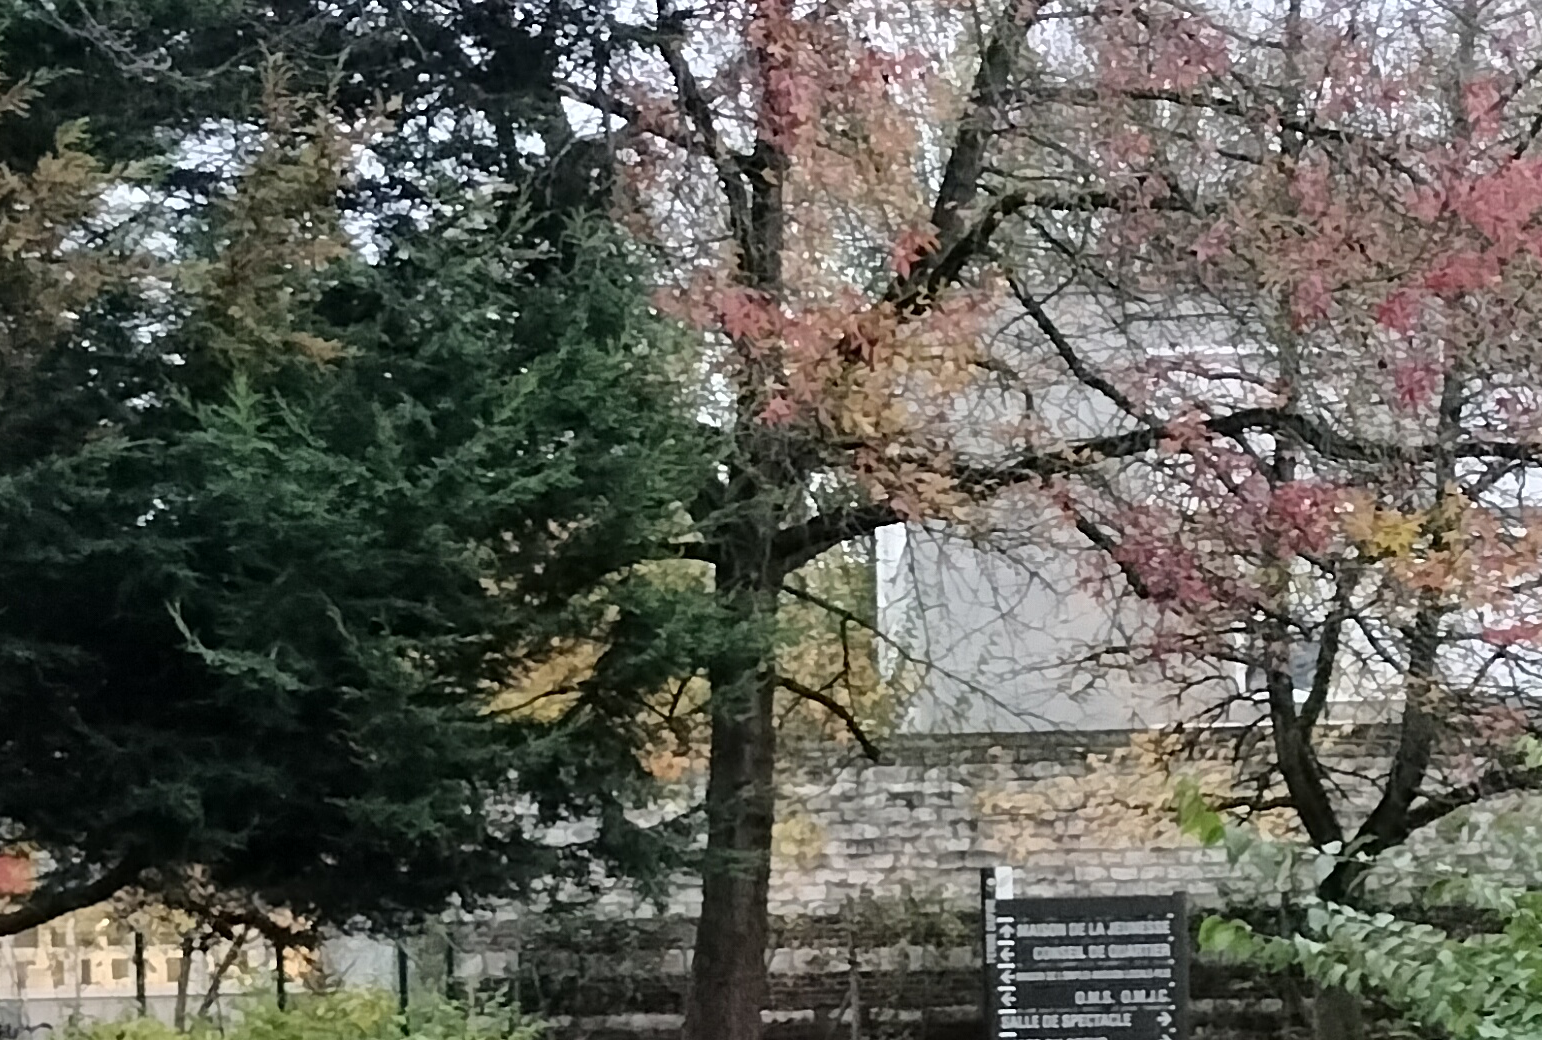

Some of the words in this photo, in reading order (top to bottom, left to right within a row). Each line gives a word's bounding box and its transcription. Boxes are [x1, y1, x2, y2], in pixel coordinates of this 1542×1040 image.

[1068, 922, 1086, 936] DE
[1088, 921, 1105, 936] LA
[1088, 945, 1106, 959] DE
[1001, 1013, 1040, 1029] SALLE
[1042, 1013, 1060, 1028] DE
[1062, 1012, 1132, 1028] SPECTACLE
